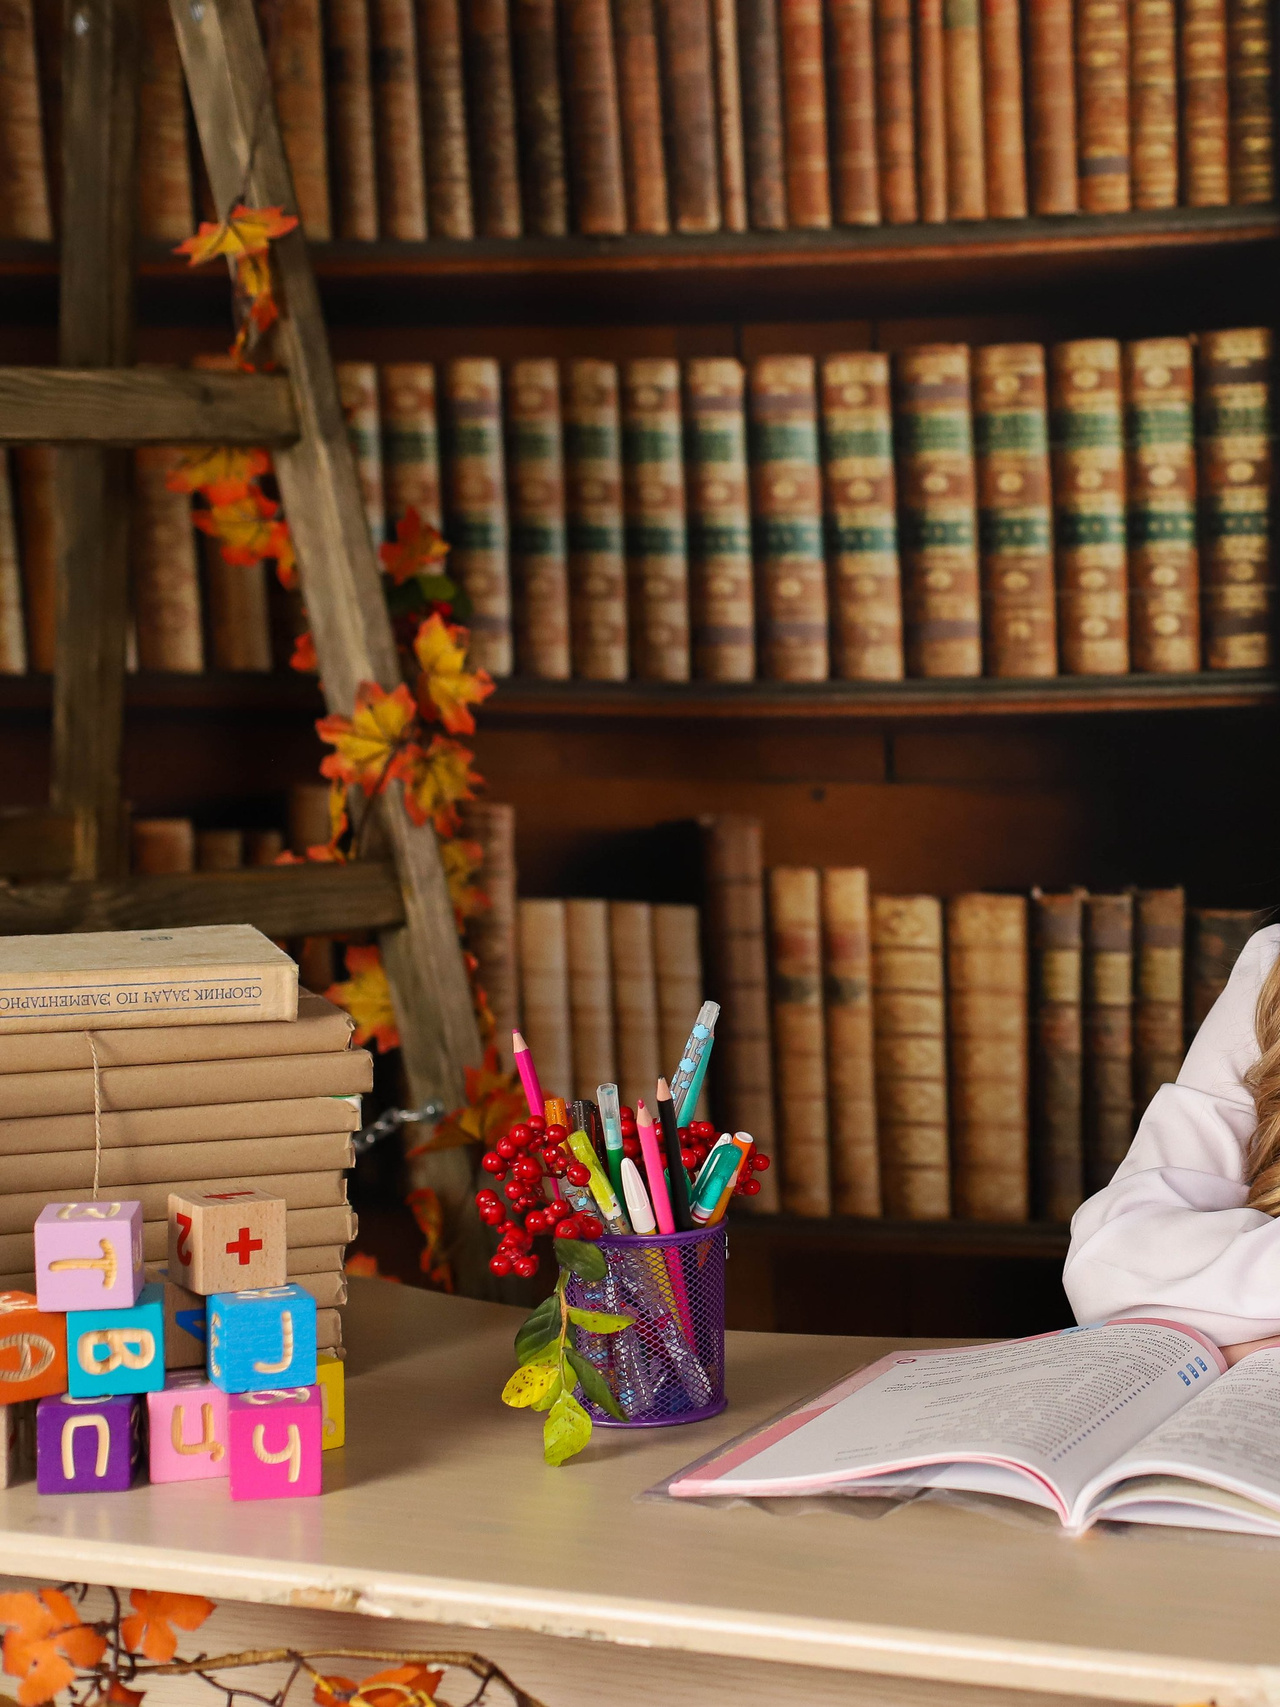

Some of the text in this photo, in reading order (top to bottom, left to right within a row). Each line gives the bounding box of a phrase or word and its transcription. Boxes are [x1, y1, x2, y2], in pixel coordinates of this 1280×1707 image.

[116, 992, 138, 1005] ПО
[144, 988, 190, 1004] ЗАДАЧ
[194, 986, 262, 1001] СБОРНИК
[77, 1328, 156, 1375] В
